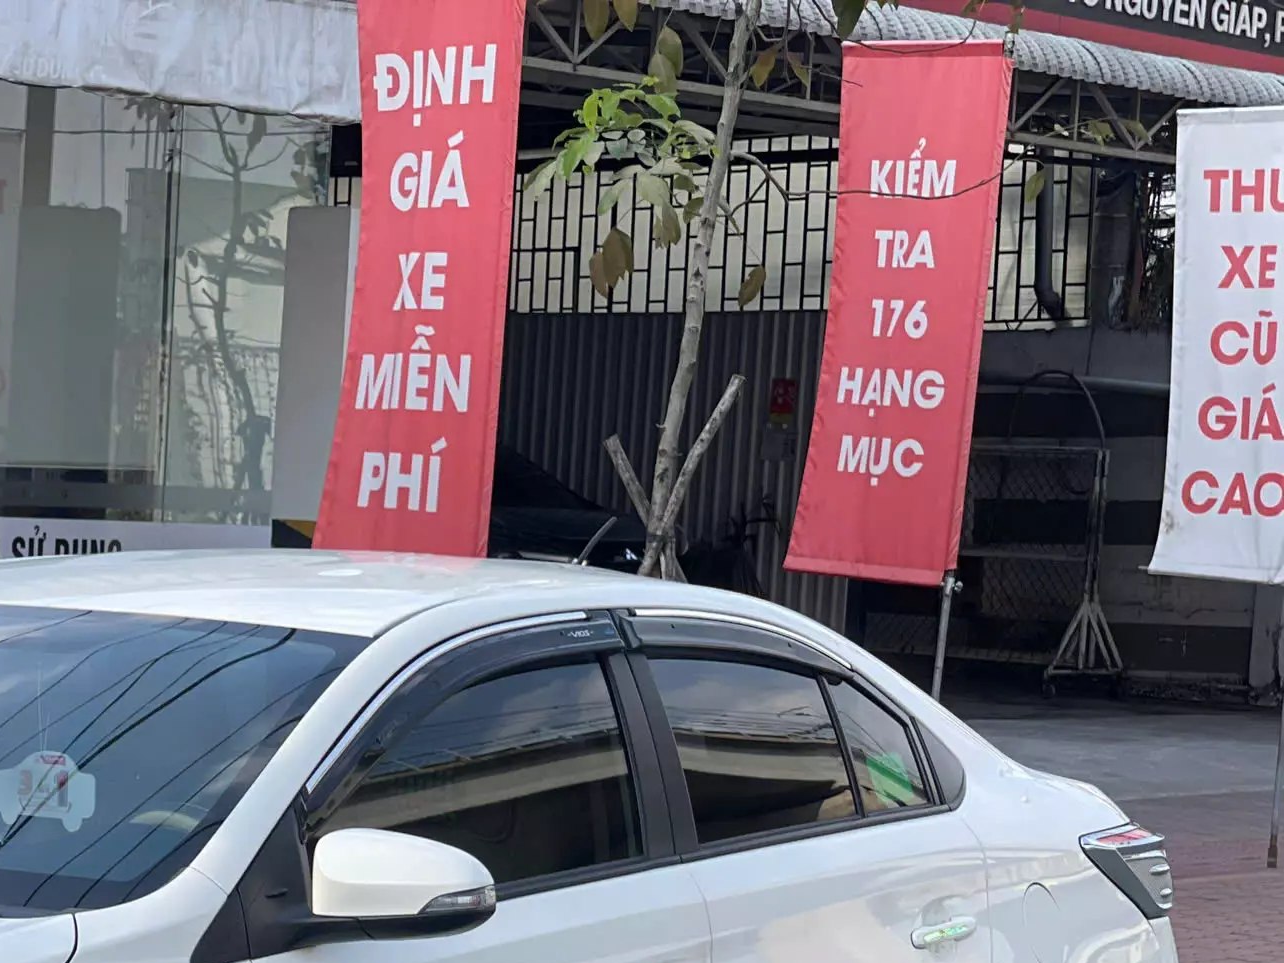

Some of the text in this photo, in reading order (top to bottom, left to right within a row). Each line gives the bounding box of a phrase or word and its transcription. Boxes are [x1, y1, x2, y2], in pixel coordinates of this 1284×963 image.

[373, 43, 497, 127] ĐỊNH
[390, 130, 470, 212] GIÁ
[869, 137, 957, 198] KIỂM
[875, 230, 936, 269] TRA
[1217, 244, 1278, 289] XE
[392, 251, 449, 312] XE
[871, 299, 929, 339] 176
[1210, 309, 1278, 366] CŨ
[355, 323, 473, 413] MIỄN
[837, 366, 945, 418] HẠNG
[1197, 382, 1284, 440] GIÁ
[356, 436, 448, 514] PHÍ
[836, 434, 925, 487] MỤC
[1181, 469, 1284, 518] CAO
